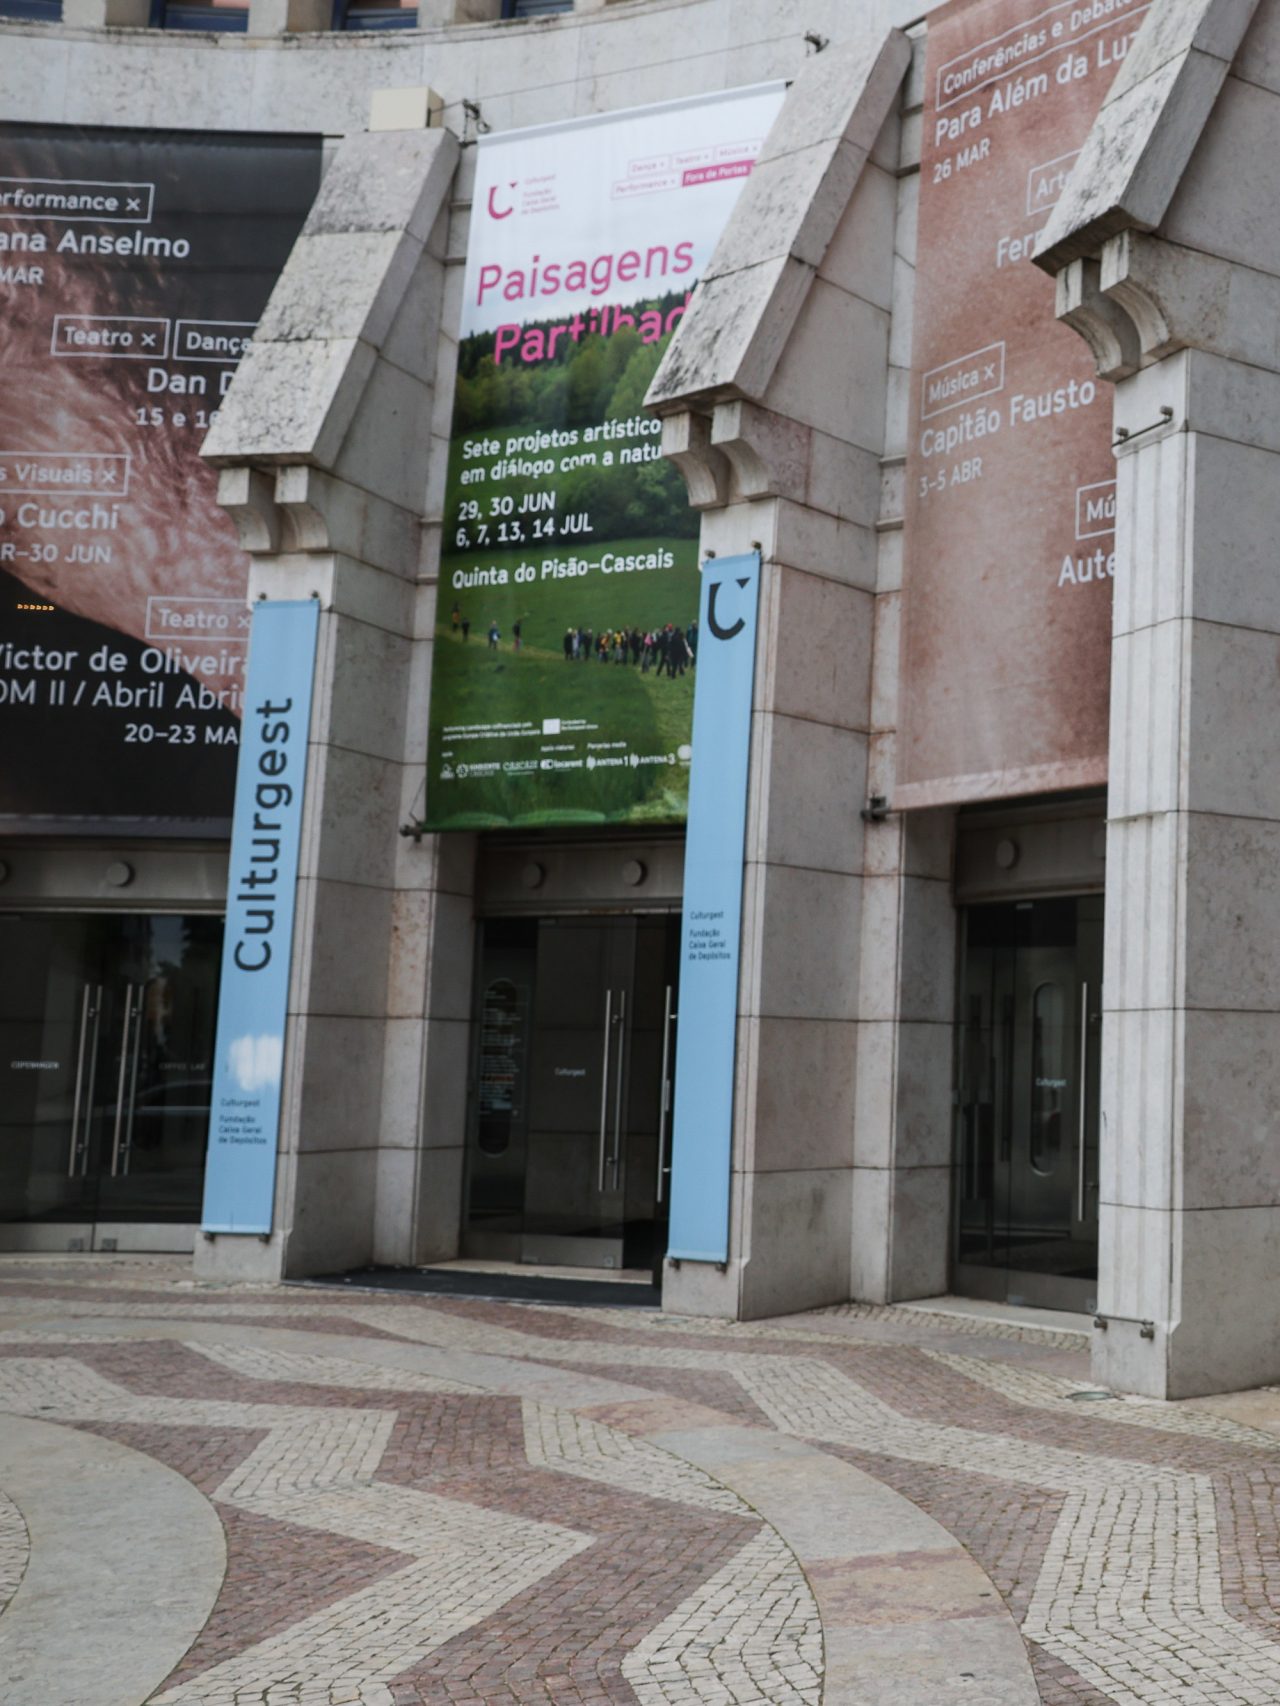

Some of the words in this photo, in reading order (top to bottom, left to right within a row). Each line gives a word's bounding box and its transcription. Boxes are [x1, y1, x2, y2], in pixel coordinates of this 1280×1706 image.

[943, 29, 1047, 94] Conferências
[1052, 21, 1063, 38] e
[934, 105, 982, 147] Para
[987, 72, 1048, 119] Além
[1056, 53, 1088, 84] da
[1097, 31, 1136, 69] Lu
[933, 157, 952, 184] 26
[956, 137, 991, 172] MAR
[0, 188, 119, 212] rformance
[56, 229, 190, 259] Anselmo
[996, 231, 1041, 268] Fer
[476, 241, 695, 306] Paisagens
[64, 327, 134, 347] Teatro
[186, 331, 252, 356] Dança
[147, 367, 207, 395] Dan
[928, 372, 979, 403] Música
[136, 406, 164, 427] 15
[172, 411, 187, 428] e
[920, 407, 1000, 458] Capitão
[1010, 378, 1096, 428] Fausto
[462, 440, 501, 460] Sete
[505, 428, 579, 457] projetos
[583, 415, 662, 444] artístico
[15, 463, 93, 484] Visuais
[460, 467, 485, 486] em
[490, 457, 555, 480] diálogo
[560, 452, 597, 473] com
[602, 450, 613, 467] a
[619, 442, 662, 465] natu
[951, 456, 983, 486] ABR
[17, 502, 120, 530] Cucchi
[458, 499, 482, 522] 29,
[489, 496, 514, 517] 30
[518, 491, 556, 515] JUN
[455, 528, 471, 549] 6,
[477, 524, 491, 546] 7,
[497, 520, 526, 543] 13,
[532, 517, 555, 538] 14
[560, 513, 594, 536] JUL
[64, 543, 112, 564] JUN
[452, 566, 509, 589] Quinta
[514, 562, 537, 584] do
[158, 608, 229, 629] Teatro
[89, 646, 128, 673] de
[92, 681, 164, 709] Abril
[175, 683, 245, 710] Abri
[233, 697, 293, 972] Culturgest
